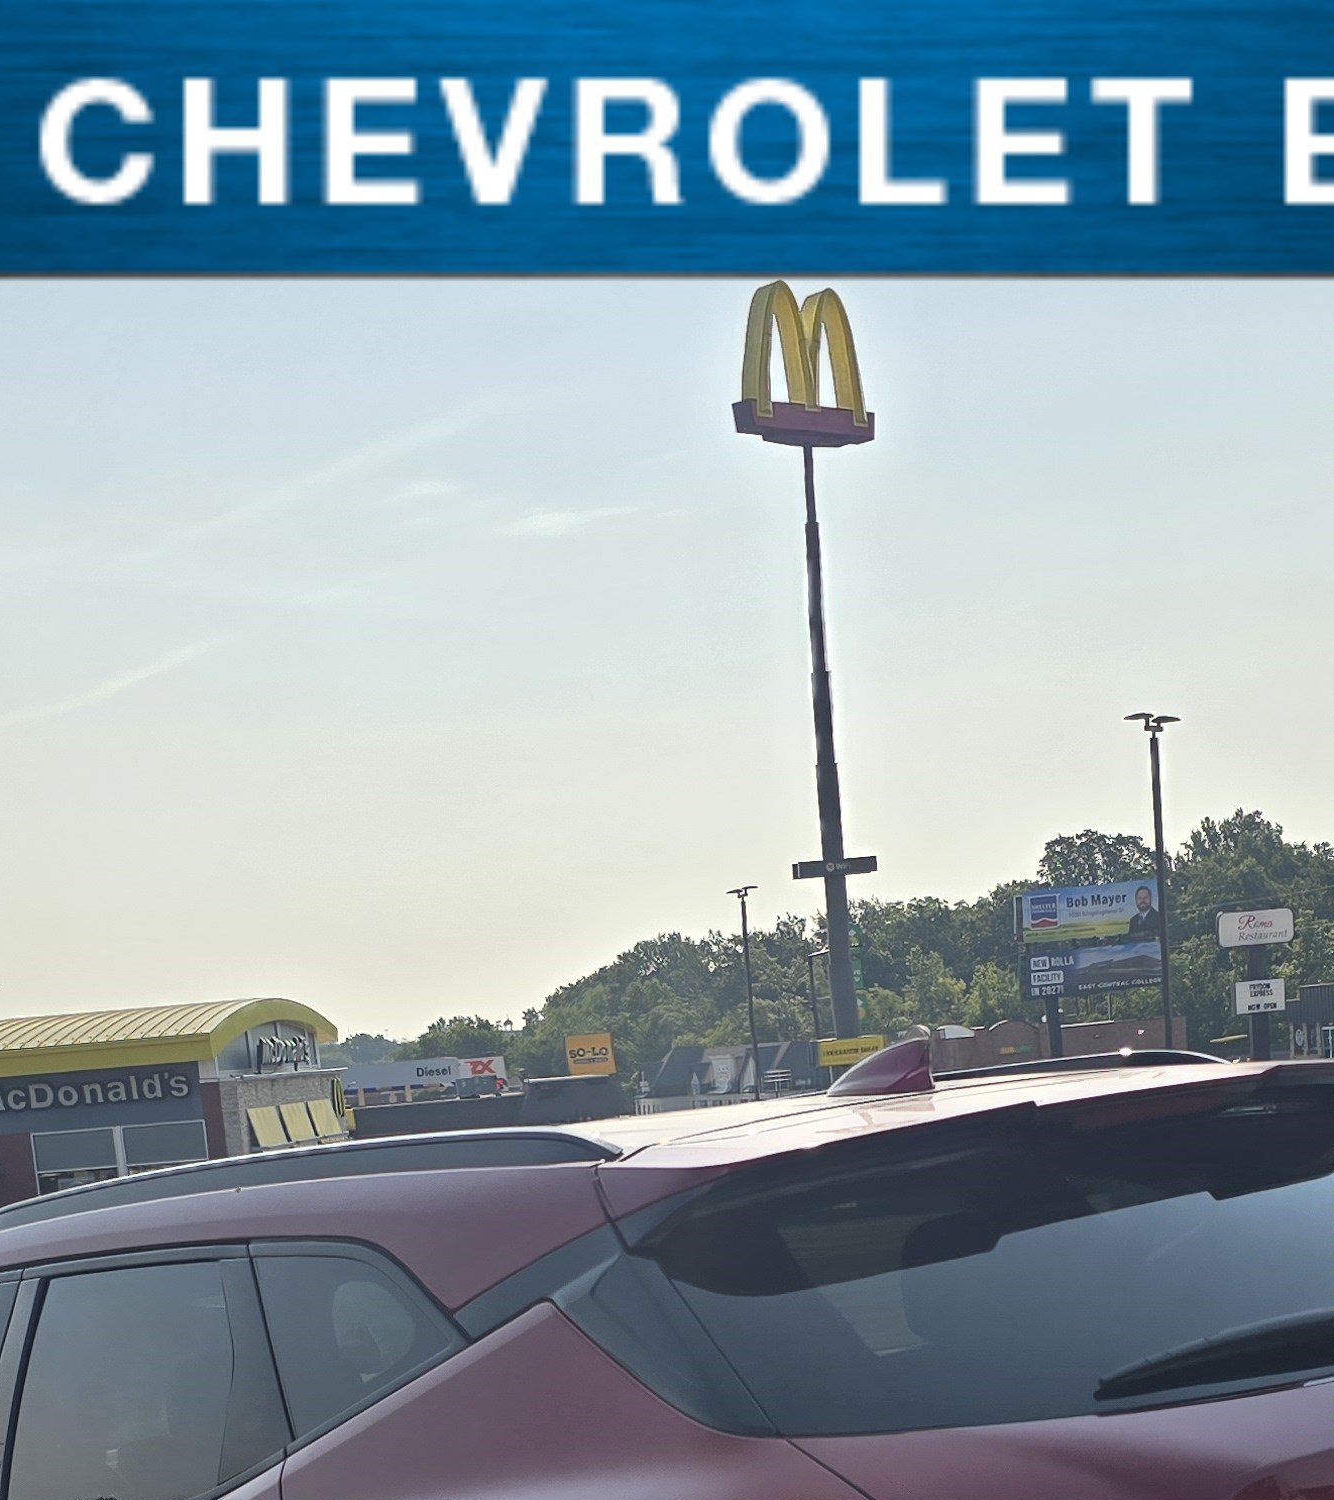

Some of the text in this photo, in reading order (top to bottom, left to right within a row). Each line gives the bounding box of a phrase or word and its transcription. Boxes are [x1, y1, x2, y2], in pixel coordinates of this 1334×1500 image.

[1067, 893, 1127, 908] Bob Mayer
[1238, 915, 1273, 930] Roma
[1238, 930, 1288, 941] Restaurant
[1051, 956, 1074, 967] ROLLA
[1033, 973, 1062, 984] FACILITY
[1263, 1002, 1277, 1010] OPEN
[416, 1066, 452, 1078] Diesel
